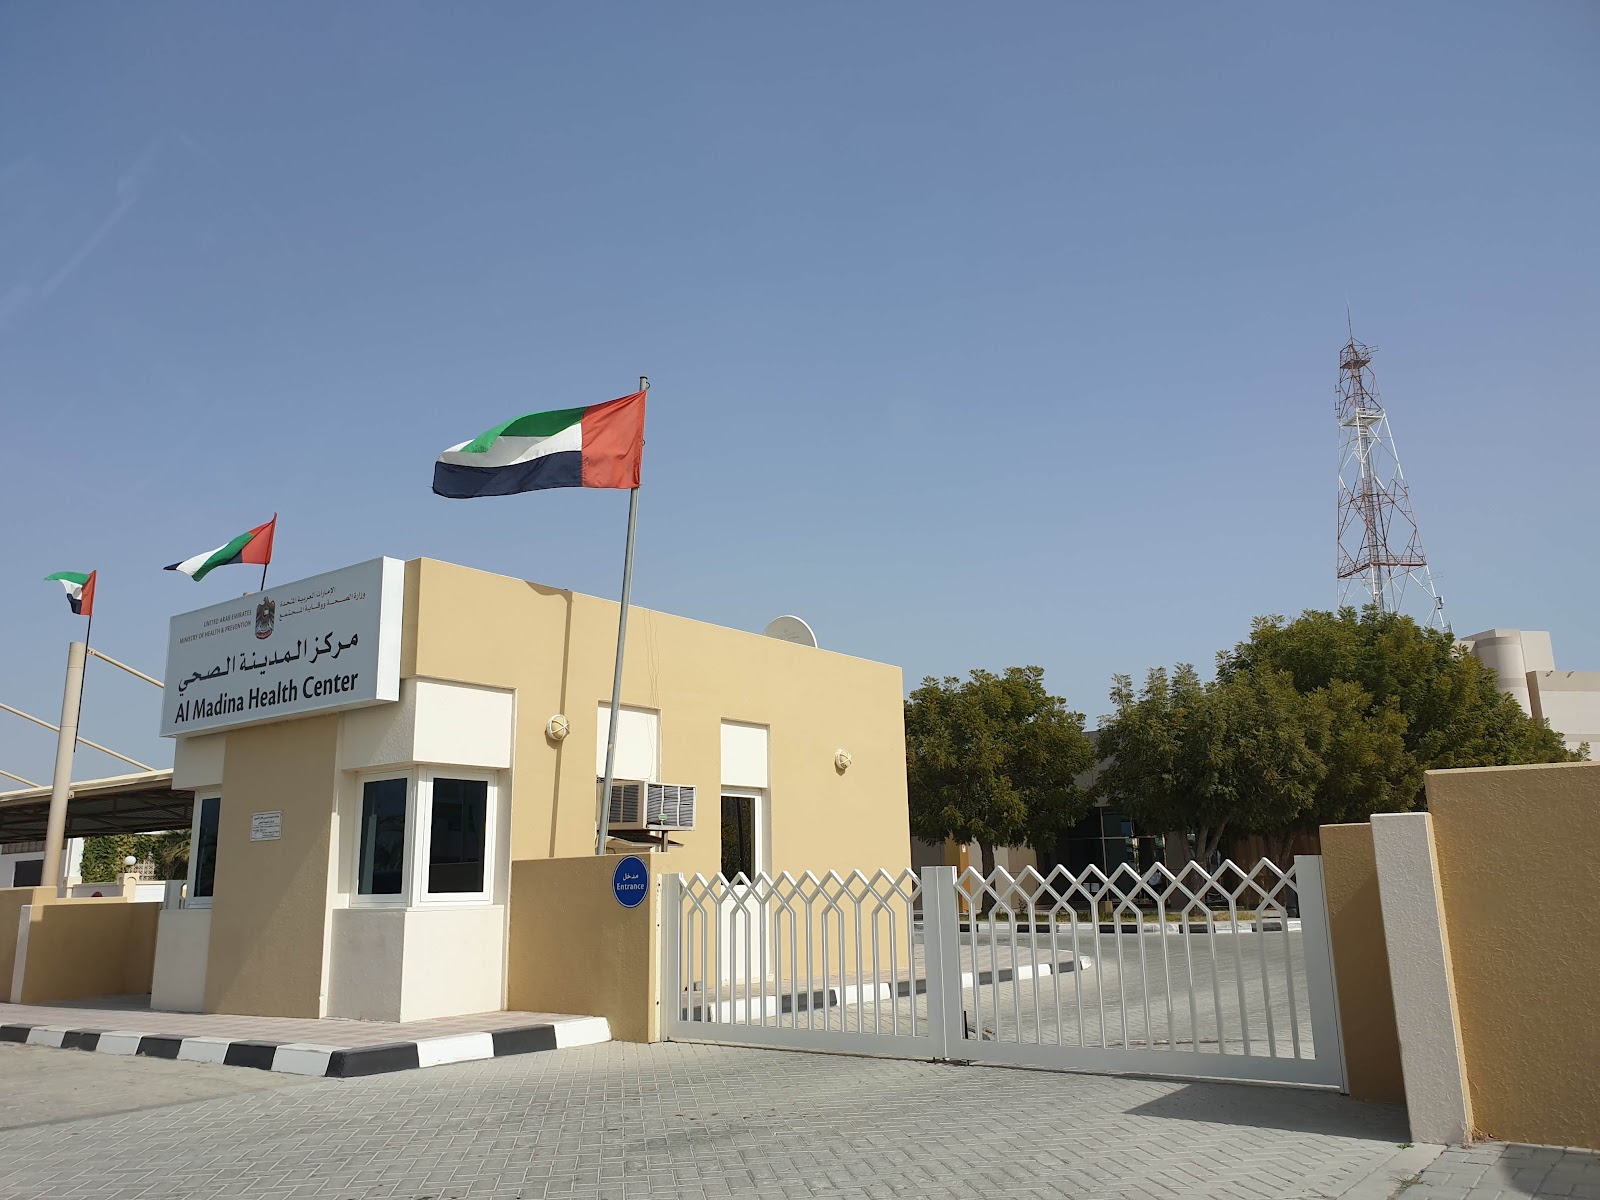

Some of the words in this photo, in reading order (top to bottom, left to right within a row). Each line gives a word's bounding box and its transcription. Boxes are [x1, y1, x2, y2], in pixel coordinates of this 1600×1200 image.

[327, 594, 353, 606] الصحة
[179, 634, 198, 644] MINISTRY
[204, 627, 220, 638] HEALTH
[224, 620, 252, 632] PREVENTION
[203, 617, 220, 628] UNITED
[220, 614, 231, 622] ARAB
[231, 609, 252, 620] EMIRATES
[239, 638, 308, 675] المدينة
[309, 631, 359, 664] مركز
[178, 655, 236, 697] الصحي
[174, 699, 190, 724] Al
[192, 693, 244, 720] Madina
[248, 679, 298, 710] Health
[302, 672, 359, 699] Center
[622, 873, 639, 881] مدخل
